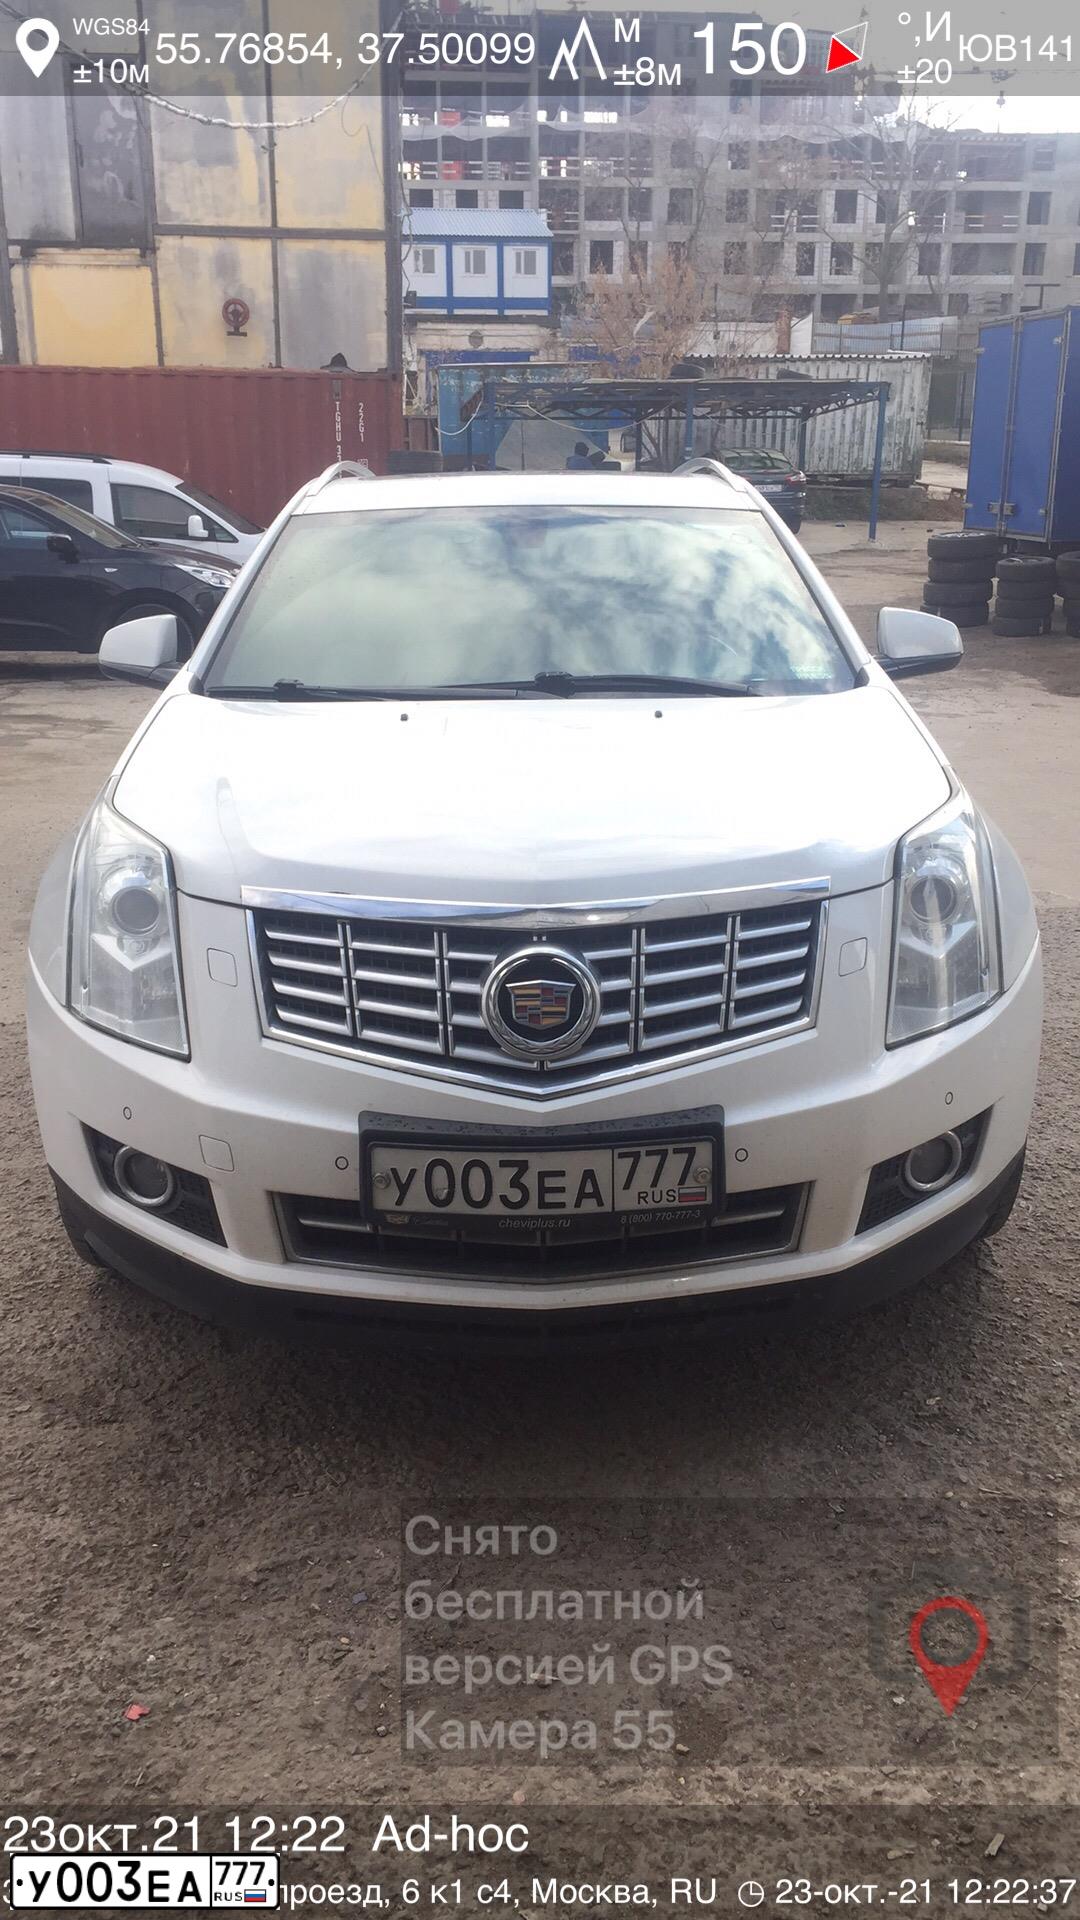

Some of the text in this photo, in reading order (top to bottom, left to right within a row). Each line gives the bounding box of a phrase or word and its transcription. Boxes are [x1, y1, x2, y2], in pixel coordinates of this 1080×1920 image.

[390, 1147, 698, 1210] У003ЕА 777
[637, 1189, 677, 1205] RUS
[498, 1217, 572, 1230] cheviplus.ru
[629, 1212, 653, 1225] (800)
